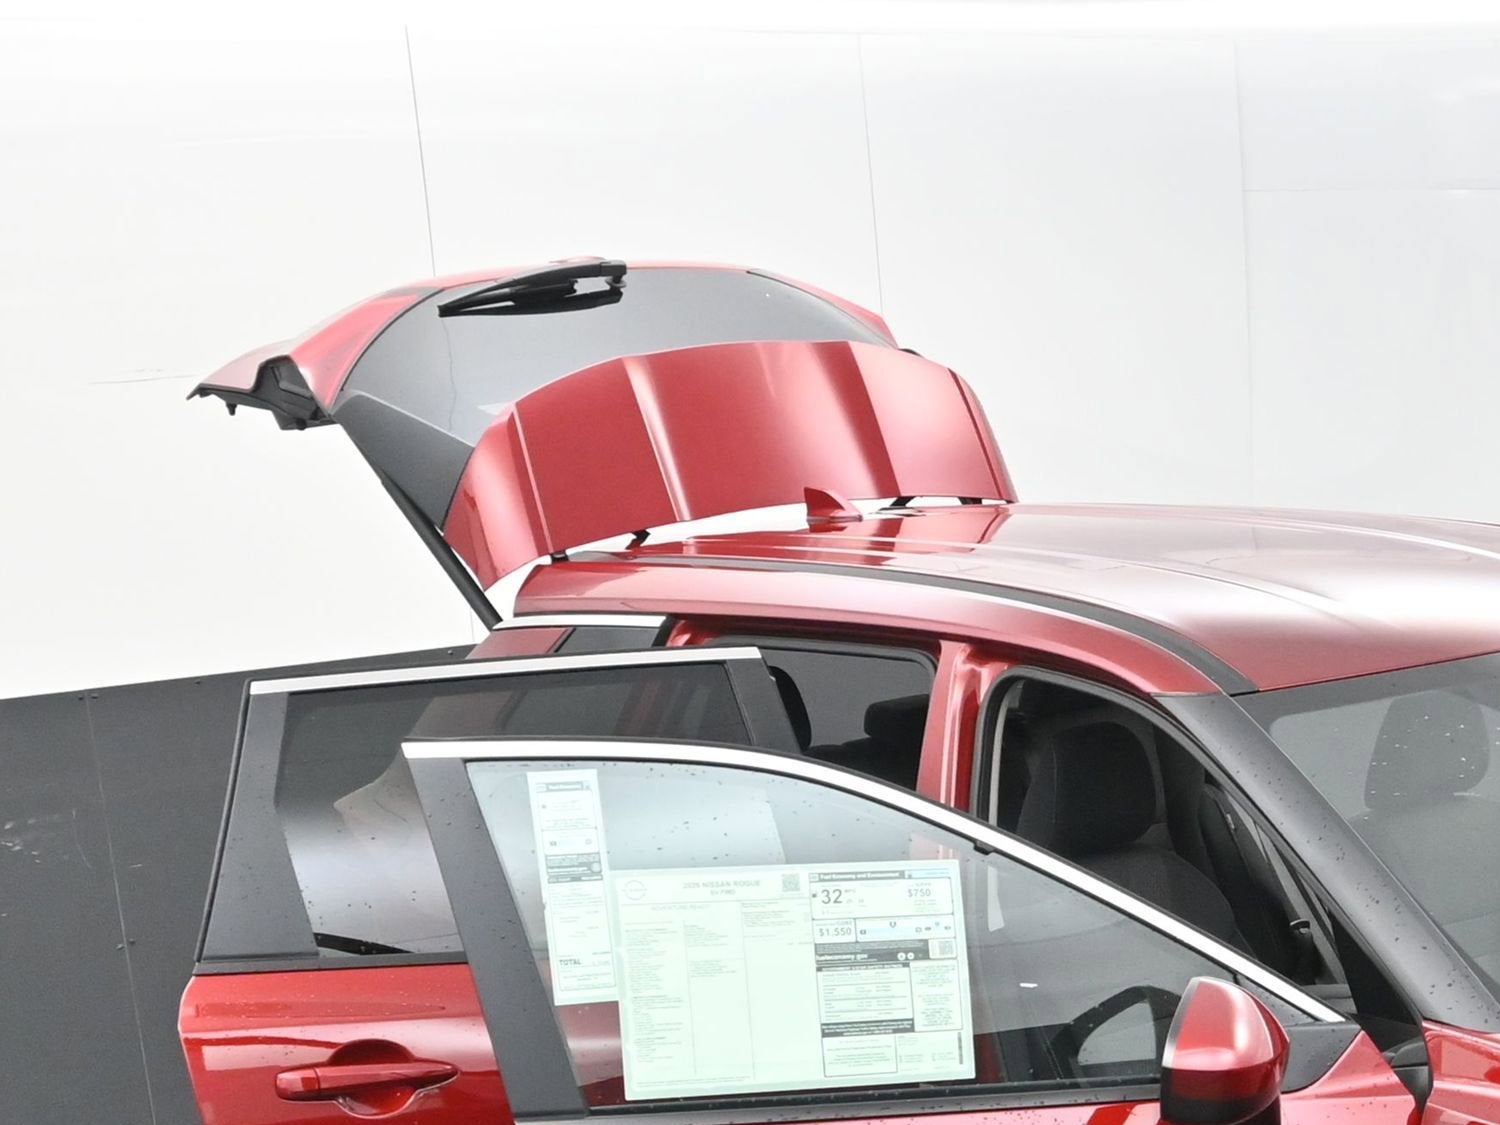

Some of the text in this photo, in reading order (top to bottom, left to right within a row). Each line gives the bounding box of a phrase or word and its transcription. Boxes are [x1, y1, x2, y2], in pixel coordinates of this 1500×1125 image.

[702, 880, 731, 888] NISSAN
[733, 879, 761, 887] ROGUE
[820, 888, 844, 905] 32
[906, 887, 932, 898] $750
[559, 958, 582, 966] TOTAL
